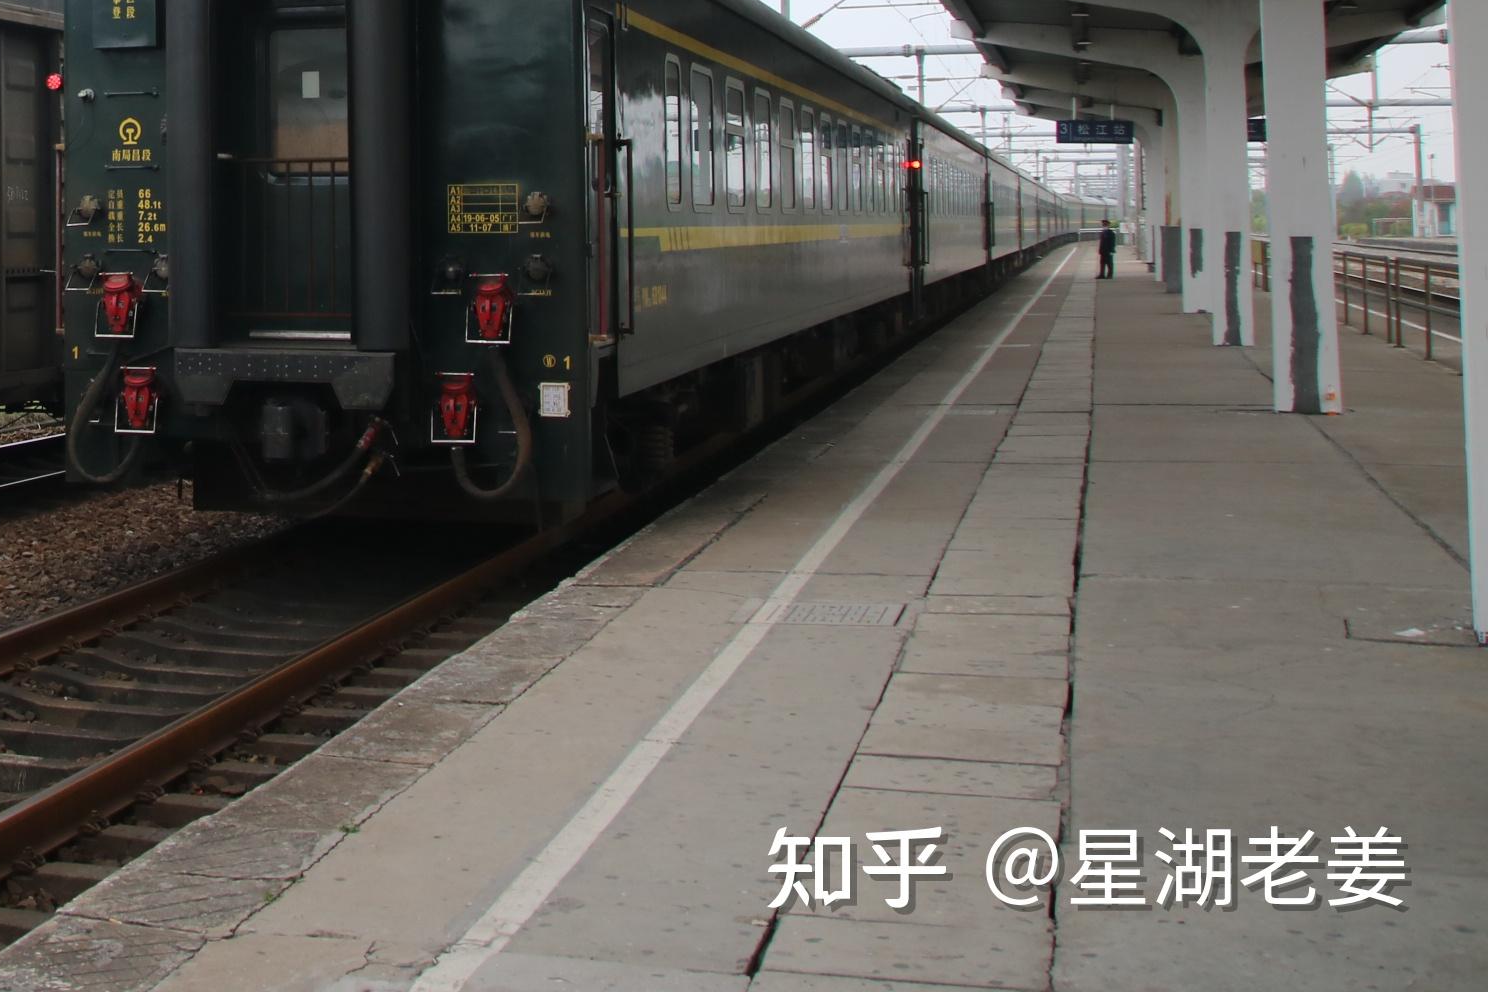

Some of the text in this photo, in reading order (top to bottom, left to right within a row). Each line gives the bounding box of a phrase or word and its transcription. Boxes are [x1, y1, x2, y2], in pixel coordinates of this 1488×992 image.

[1060, 123, 1125, 135] 3 松江站
[138, 189, 151, 198] 66
[450, 187, 461, 195] A1
[138, 200, 161, 209] 48.1t
[450, 196, 461, 204] A2
[450, 205, 461, 213] A3
[138, 211, 157, 221] 7.2t
[450, 214, 461, 222] A4
[463, 214, 500, 222] 19-06-05
[138, 223, 166, 232] 26.6m
[450, 223, 461, 231] A5
[470, 223, 492, 232] 11-07
[138, 234, 153, 243] 2.4
[72, 347, 79, 359] 1
[563, 355, 571, 370] 1
